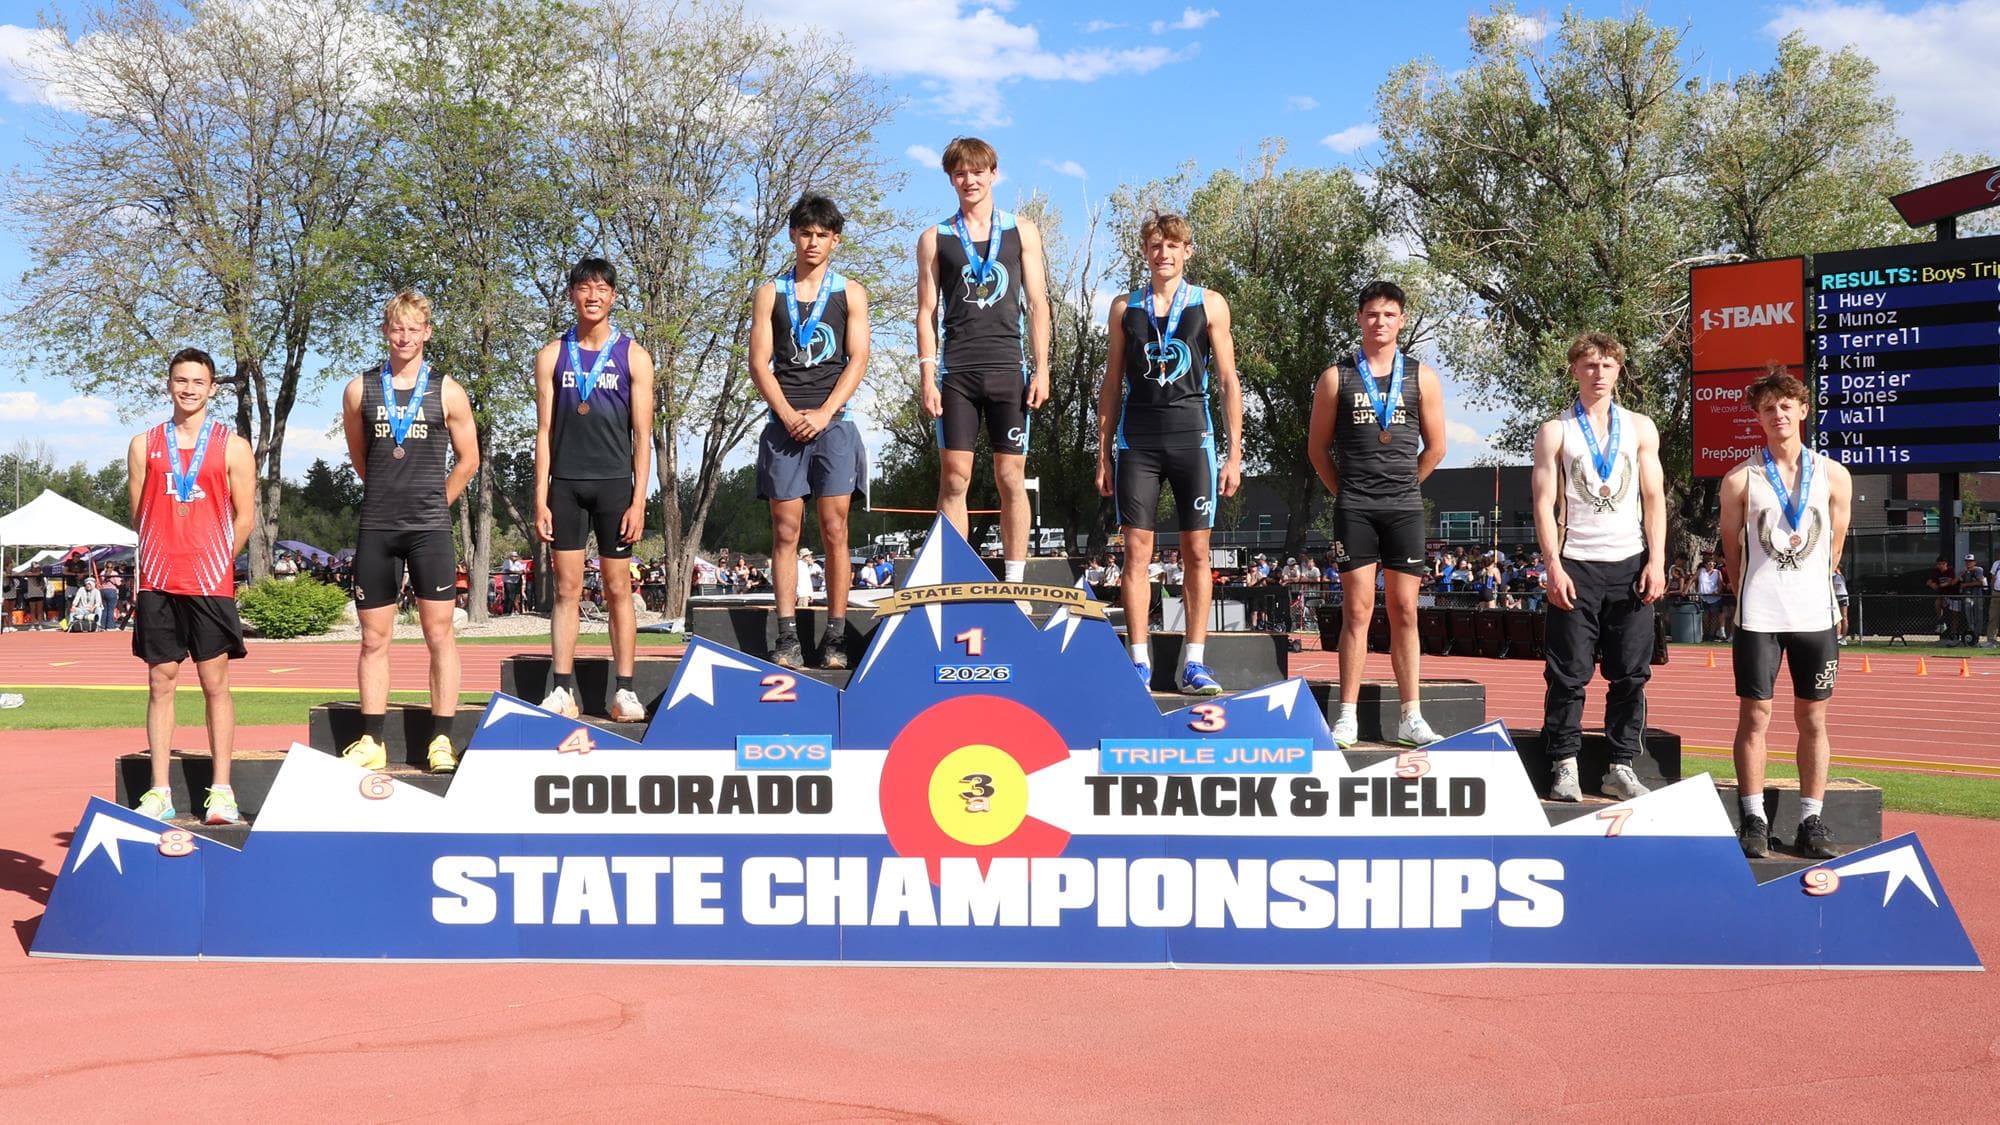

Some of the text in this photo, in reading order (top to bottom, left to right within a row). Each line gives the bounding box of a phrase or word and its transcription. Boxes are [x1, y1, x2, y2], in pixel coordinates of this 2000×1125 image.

[1821, 261, 2000, 290] RESULTS: Boys Tri
[1818, 292, 1887, 310] 1 Huey
[1817, 311, 1897, 329] 2 Munoz
[1818, 327, 1920, 350] 3 Terrell
[1818, 352, 1876, 370] 4 Kim
[1820, 371, 1911, 391] 5 Dozier
[1695, 388, 1713, 401] CO
[1715, 387, 1743, 402] Prep
[1818, 390, 1898, 405] 6 Jones
[1352, 409, 1407, 424] SPRGS
[1818, 406, 1885, 425] 7 Wall
[1818, 431, 1863, 446] 8 Yu
[1702, 445, 1761, 461] PrepSpotli
[1841, 446, 1910, 464] Bullis
[900, 585, 1079, 600] STATE CHAMPION
[955, 627, 984, 656] 1
[938, 666, 1010, 681] 2026
[760, 674, 797, 702] 2
[1188, 703, 1227, 733] 3
[557, 728, 596, 754] 4
[744, 743, 826, 760] BOYS
[1110, 747, 1306, 764] TRIPLE JUMP
[1395, 751, 1432, 779] 5
[359, 773, 394, 800] 6
[534, 774, 833, 815] COLORADO
[959, 773, 995, 799] 3
[1085, 775, 1487, 818] TRACK & FIELD
[1596, 808, 1633, 838] 7
[158, 829, 196, 857] 8
[432, 855, 1565, 929] STATE CHAMPIONSHIPS
[1800, 867, 1840, 897] 9
